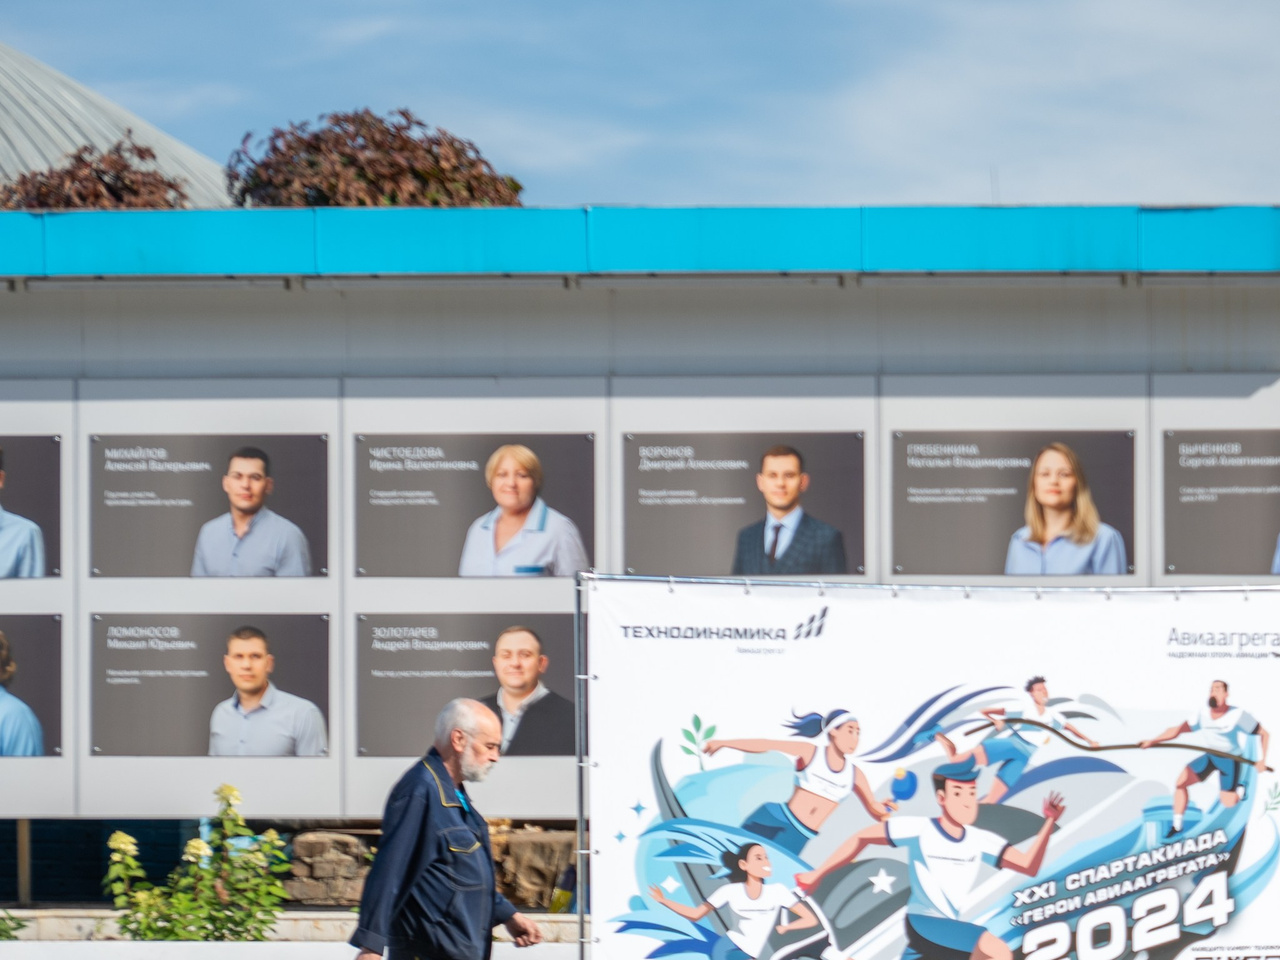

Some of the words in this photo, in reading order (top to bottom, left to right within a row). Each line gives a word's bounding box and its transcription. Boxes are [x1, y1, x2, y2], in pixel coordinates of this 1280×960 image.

[368, 446, 446, 460] ЧИСТОЕДОВА
[638, 445, 695, 458] ВОРОНОВ
[104, 460, 147, 472] Алексей
[369, 459, 403, 473] Ирина
[404, 459, 479, 471] Валентиновна
[638, 459, 686, 472] Дмитрий
[907, 456, 952, 468] Наталья
[952, 455, 1032, 469] Владимировна
[106, 626, 181, 639] ЛОМОНОСОВ
[371, 626, 439, 639] ЗОЛОТАРЕВ
[620, 625, 787, 641] ТЕХНОДИНАМИКА
[106, 638, 147, 649] Михаил
[148, 638, 198, 651] Юрьевич
[371, 639, 411, 653] Андрей
[411, 639, 490, 652] Владимирович
[1012, 881, 1057, 907] XXI
[1065, 830, 1229, 891] СПАРТАКИАДА
[1084, 852, 1231, 906] АВИААГРЕГАТА»
